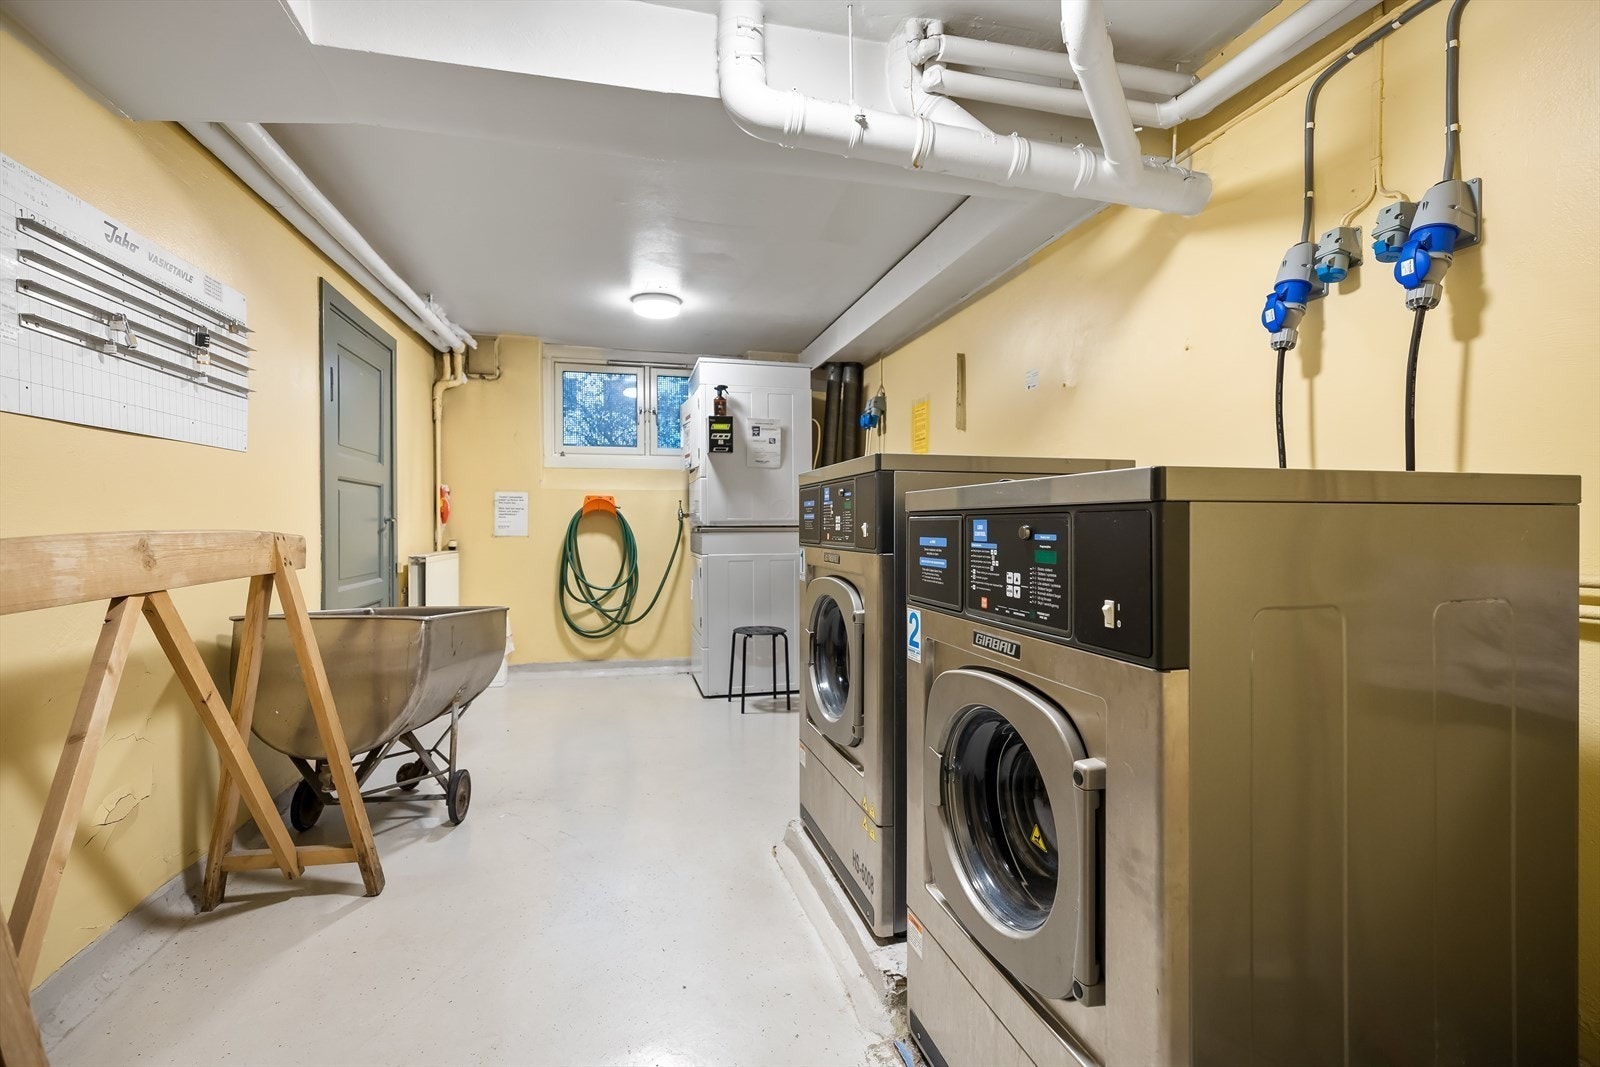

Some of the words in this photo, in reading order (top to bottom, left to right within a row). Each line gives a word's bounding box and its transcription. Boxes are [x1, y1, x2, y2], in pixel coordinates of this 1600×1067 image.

[19, 208, 24, 218] 1
[103, 220, 140, 253] Jako
[148, 251, 195, 284] VASKETAVLE
[909, 611, 920, 649] 2
[975, 633, 1017, 656] GIRBAU
